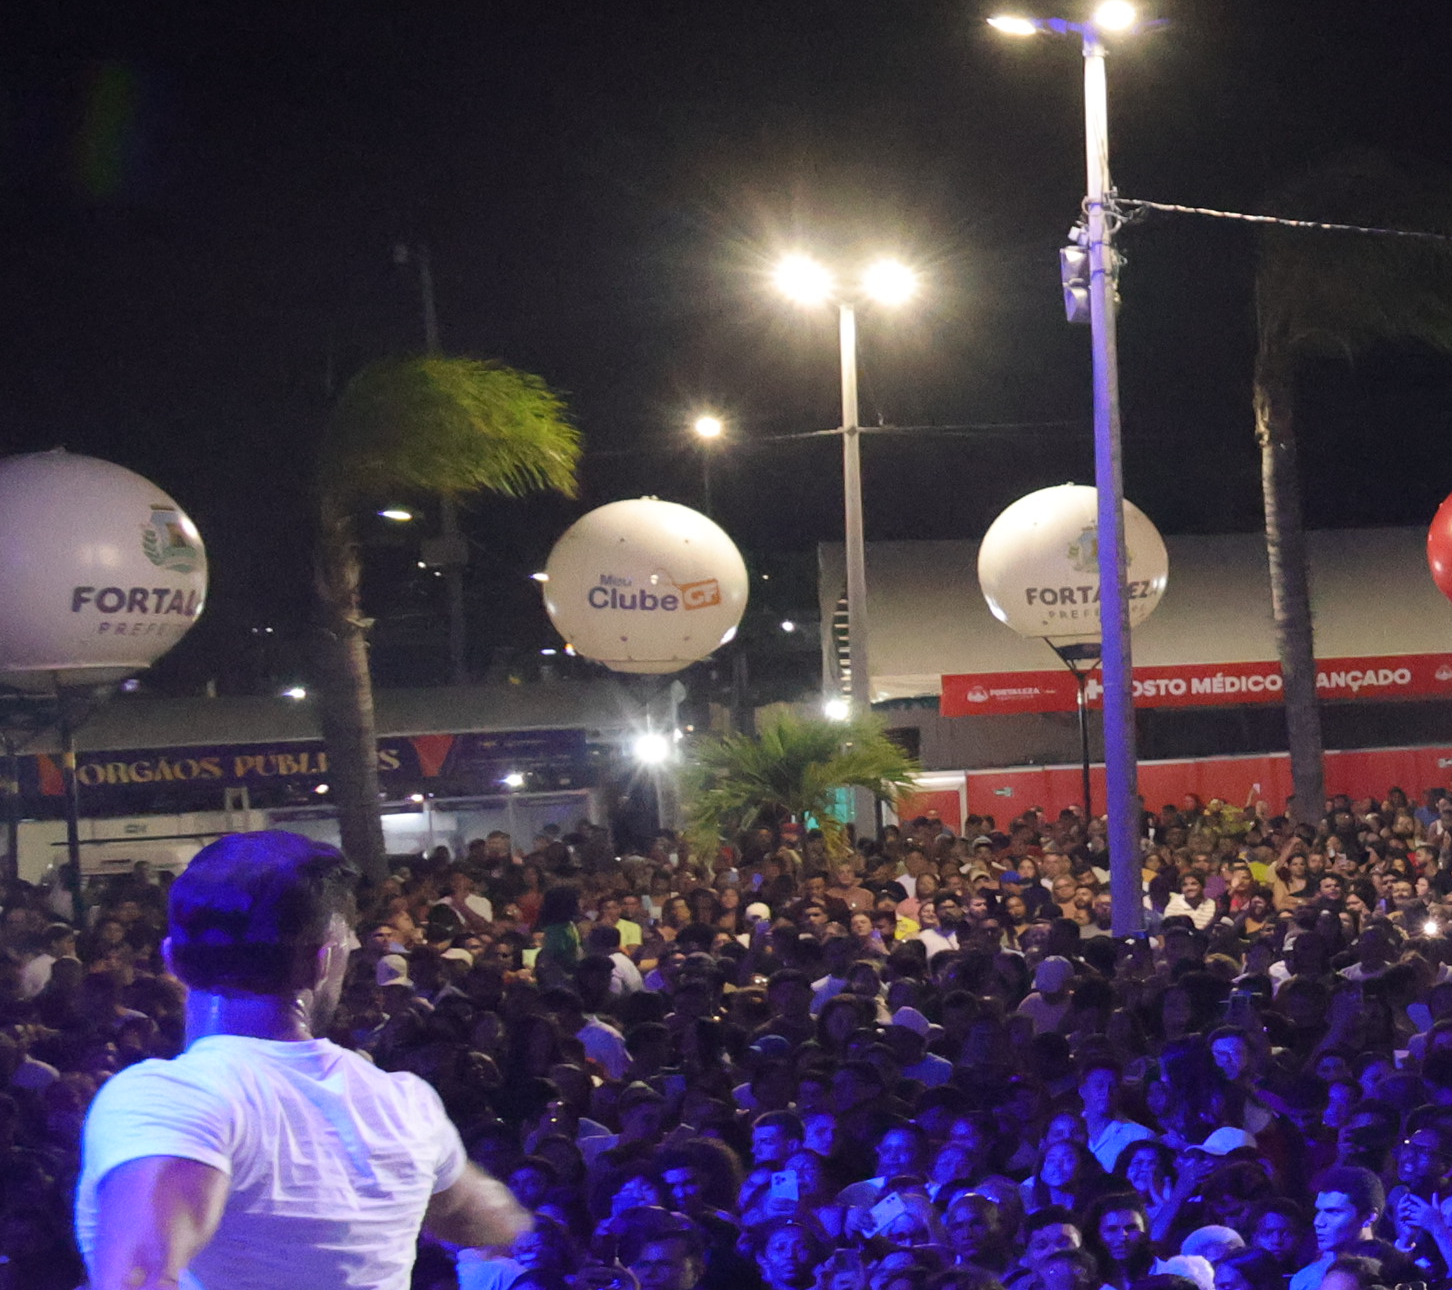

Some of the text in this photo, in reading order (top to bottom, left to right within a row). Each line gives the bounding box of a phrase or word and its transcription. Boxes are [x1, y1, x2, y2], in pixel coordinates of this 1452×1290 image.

[588, 586, 680, 611] Clube
[1131, 668, 1412, 697] OSTO MÉDICO ANÇADO
